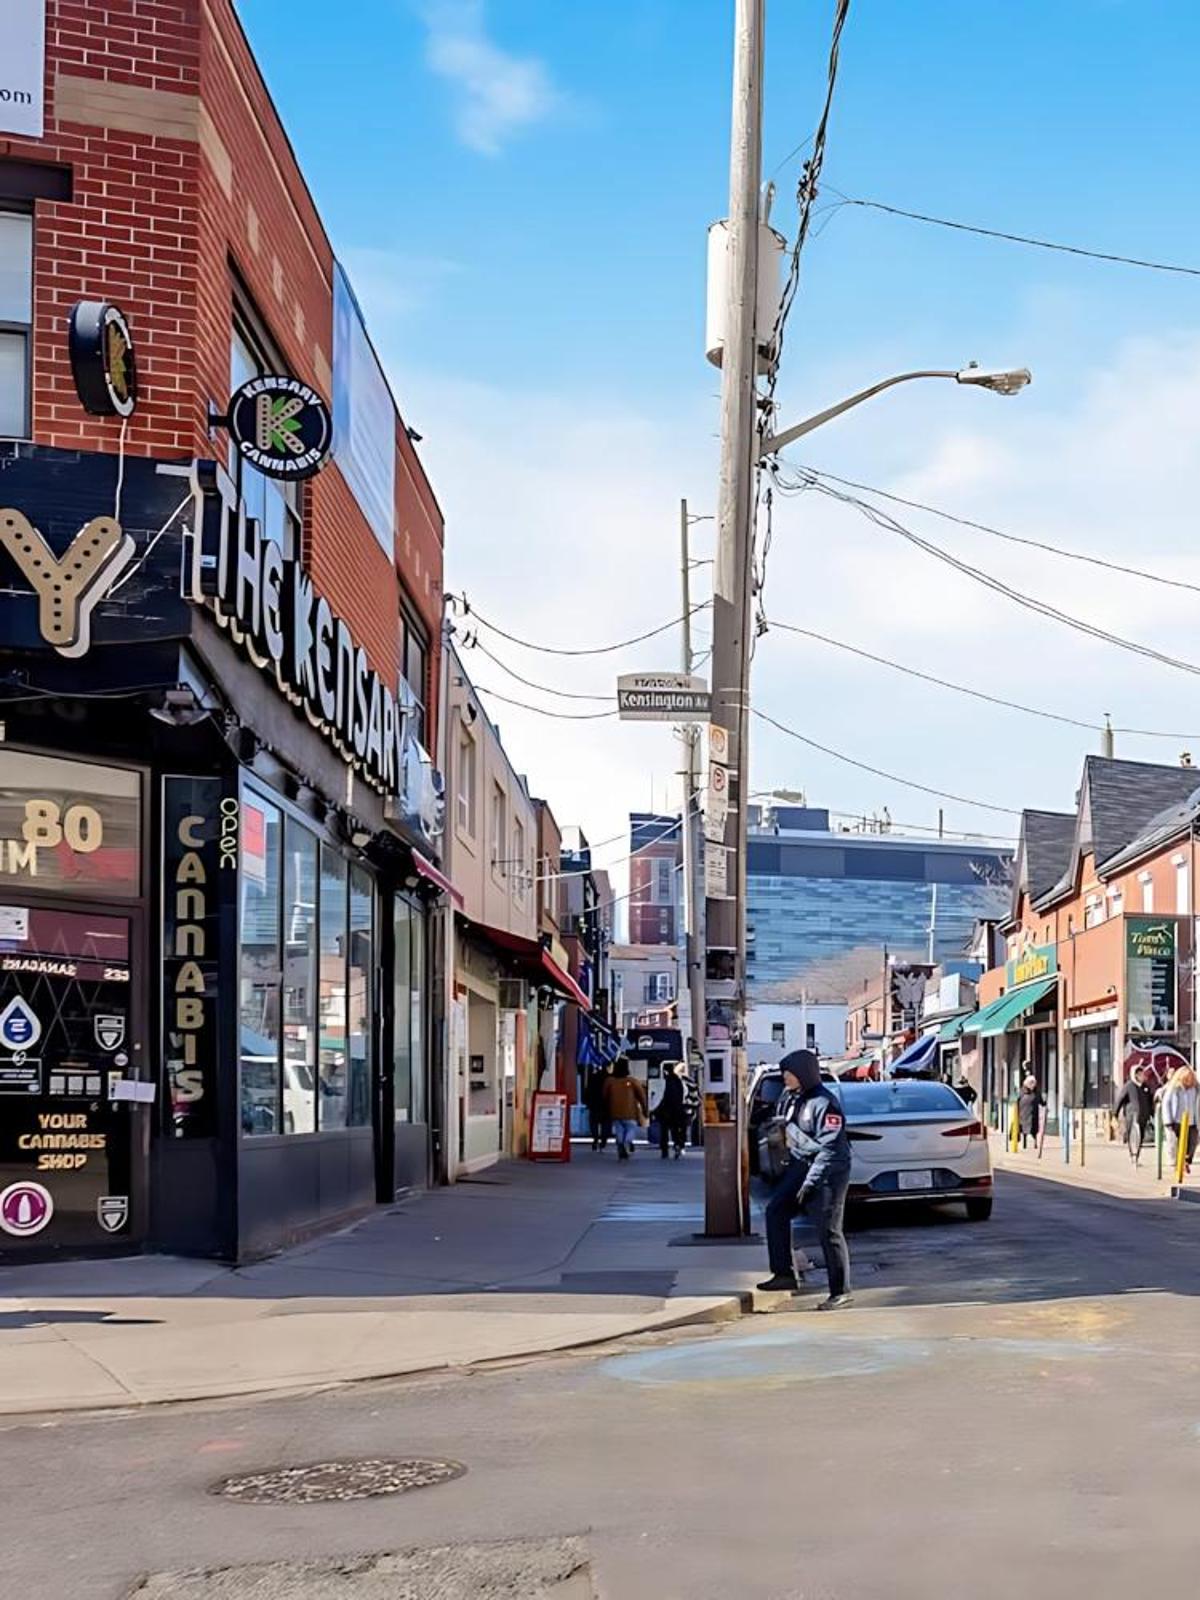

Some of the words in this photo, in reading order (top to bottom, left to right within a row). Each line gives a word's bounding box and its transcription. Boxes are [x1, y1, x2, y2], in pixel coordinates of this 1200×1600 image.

[241, 377, 322, 406] KENSARY
[240, 441, 321, 471] CANNABIS
[620, 691, 694, 711] Kensington
[22, 799, 103, 853] 80
[175, 815, 207, 1102] CANNABIS
[38, 1113, 87, 1129] YOUR
[18, 1133, 106, 1150] CANNABIS
[37, 1153, 87, 1170] SHOP
